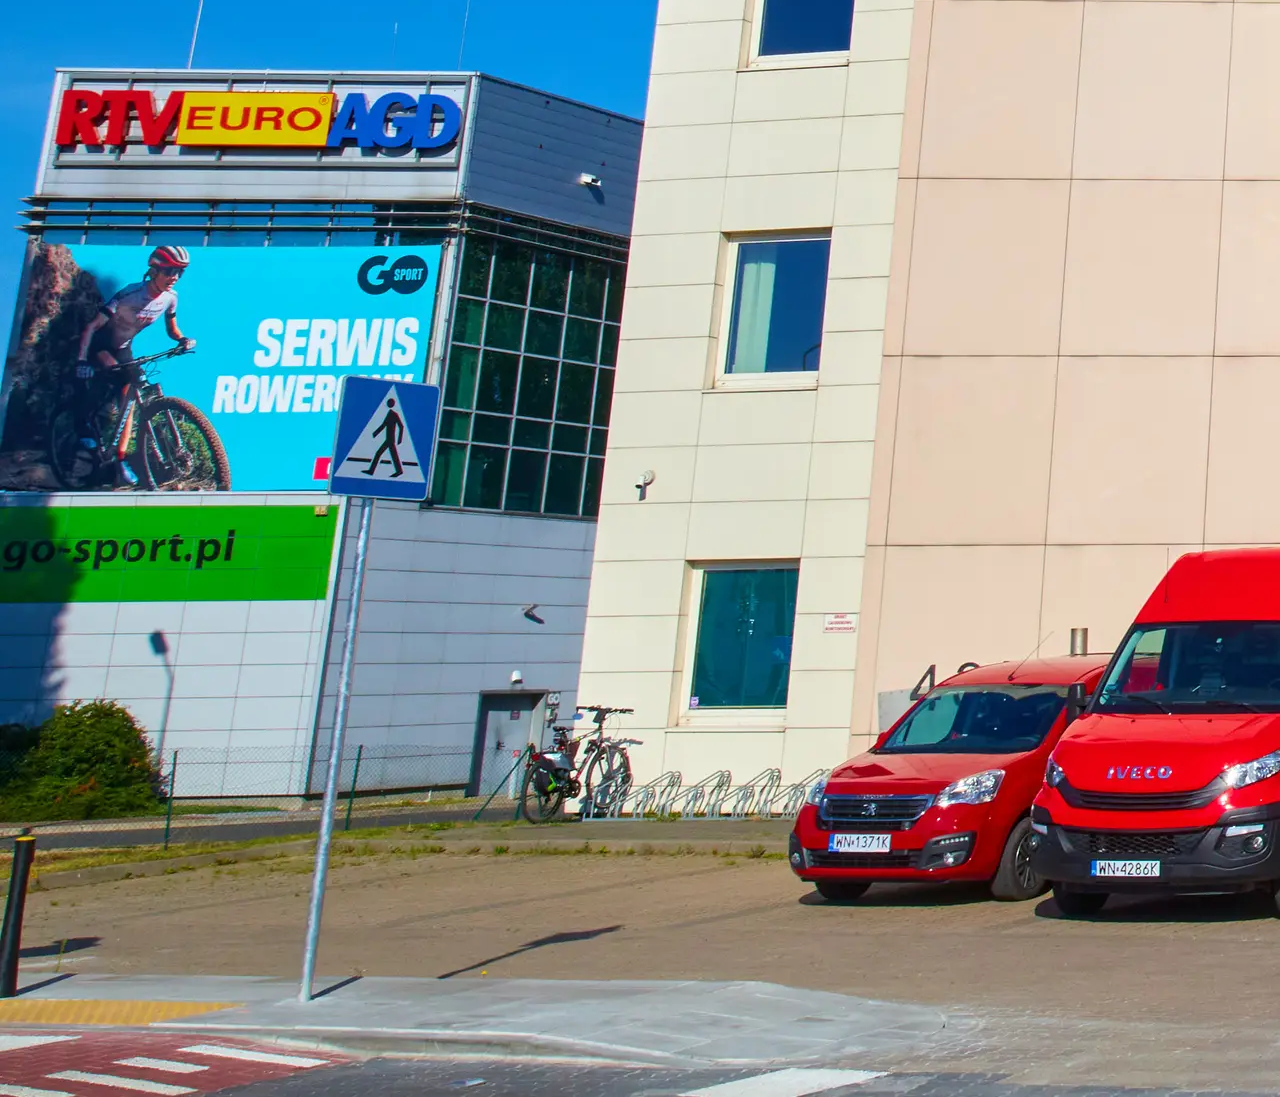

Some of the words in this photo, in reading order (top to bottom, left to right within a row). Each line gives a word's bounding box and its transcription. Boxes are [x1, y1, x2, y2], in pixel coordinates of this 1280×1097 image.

[55, 89, 186, 145] RTV
[185, 105, 323, 132] EURO
[327, 91, 462, 148] AGD
[394, 268, 424, 281] SPORT
[253, 317, 420, 368] SERWIS
[212, 374, 415, 414] ROWER
[3, 529, 236, 571] go-sport.pl
[1106, 766, 1172, 779] IVECO
[1098, 862, 1116, 875] WN
[1120, 862, 1158, 876] 4286K
